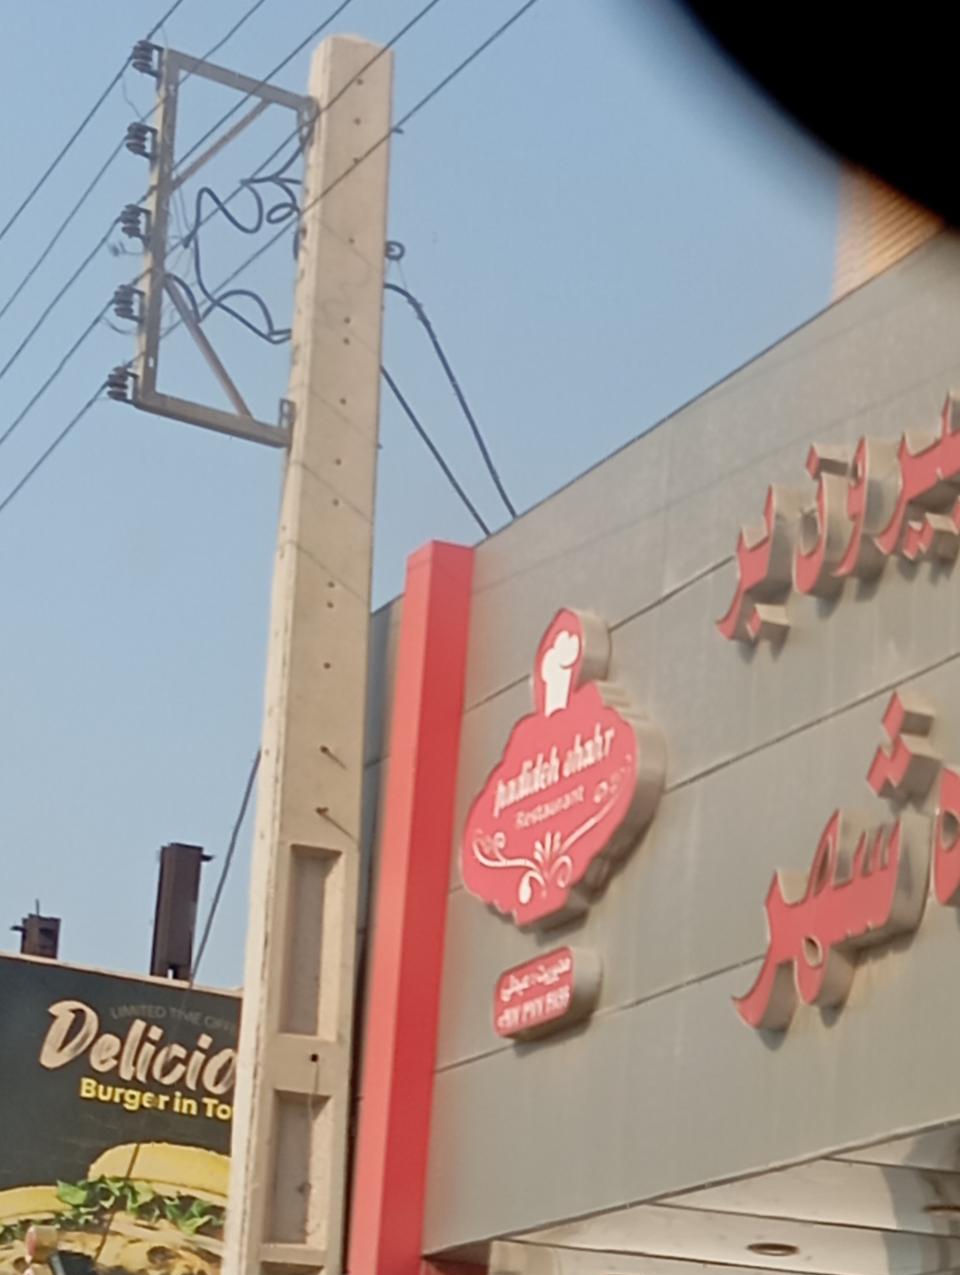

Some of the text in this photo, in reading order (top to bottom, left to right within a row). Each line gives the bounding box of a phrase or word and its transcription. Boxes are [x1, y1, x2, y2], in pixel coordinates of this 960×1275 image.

[715, 484, 778, 642] بر
[730, 691, 910, 1030] شهر
[79, 1076, 171, 1112] Burger
[172, 1090, 199, 1116] in
